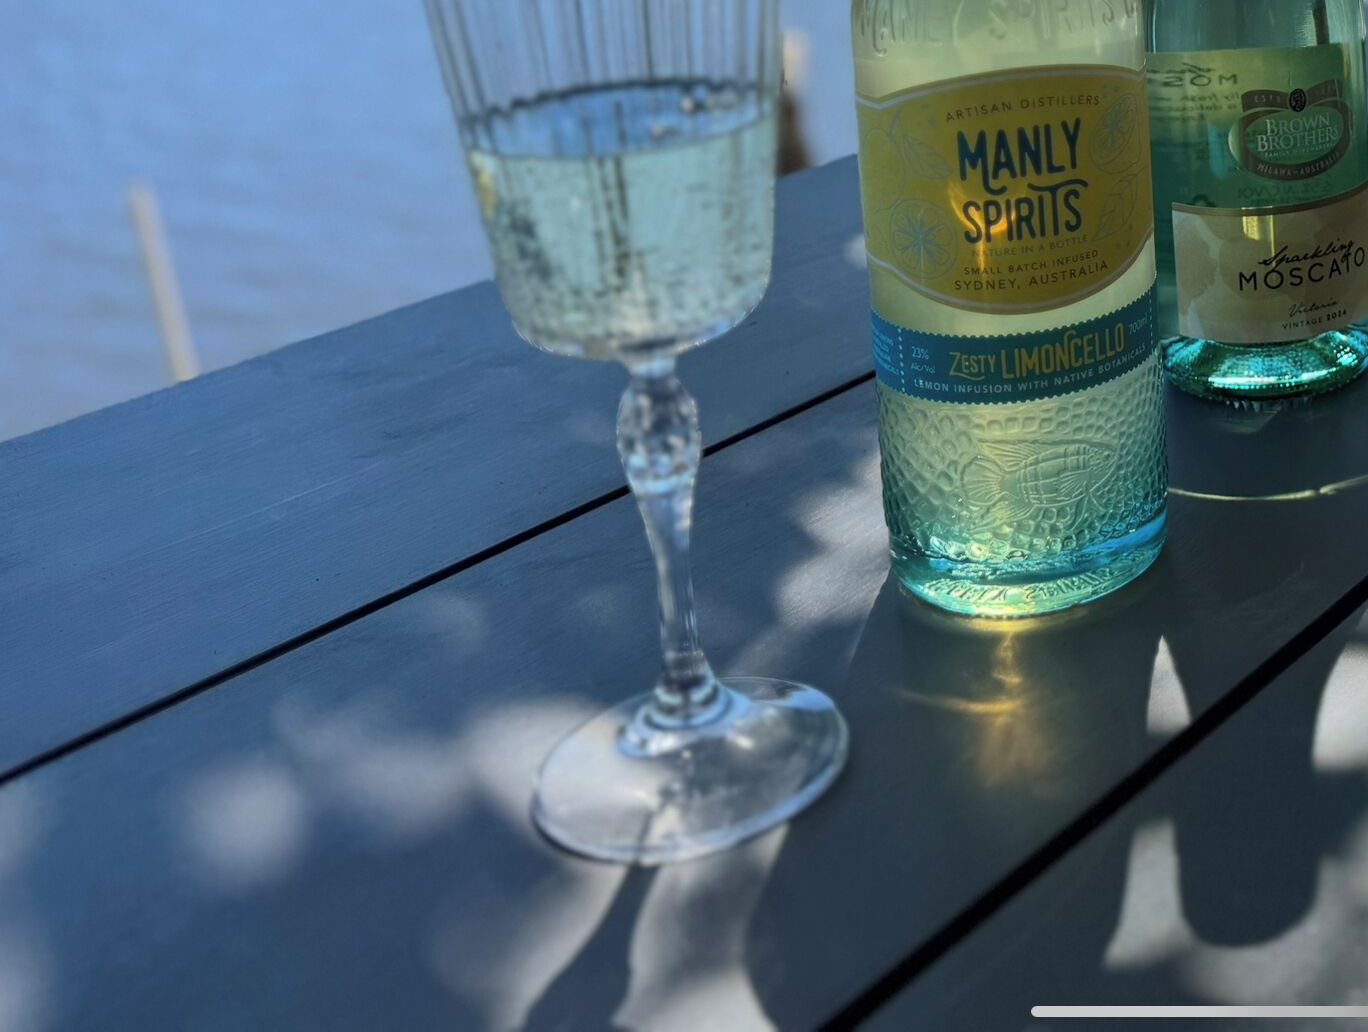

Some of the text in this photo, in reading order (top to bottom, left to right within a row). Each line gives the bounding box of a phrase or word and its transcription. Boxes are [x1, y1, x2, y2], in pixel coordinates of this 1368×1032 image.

[945, 95, 1101, 123] ARTISAN DISTILLERS
[1257, 125, 1339, 152] BROTHERS
[1265, 112, 1330, 137] BROWN
[957, 117, 1081, 195] MANLY
[962, 178, 1089, 244] SPIRITS
[971, 234, 1088, 258] NATURE IN A BOTTLE
[1258, 238, 1355, 271] Sparkling
[954, 259, 1109, 291] SYDNEY, AUSTRALIA
[964, 249, 1098, 276] SMALL BATCH INFUSED
[1239, 247, 1366, 291] MOSCATO
[1128, 314, 1148, 334] 700ml
[1282, 315, 1323, 330] VINTAGE
[911, 346, 929, 360] 23%
[1000, 323, 1125, 381] LIMONCELLO
[914, 343, 1146, 394] LEMON INFUSION WITH NATIVE BOTANICALS
